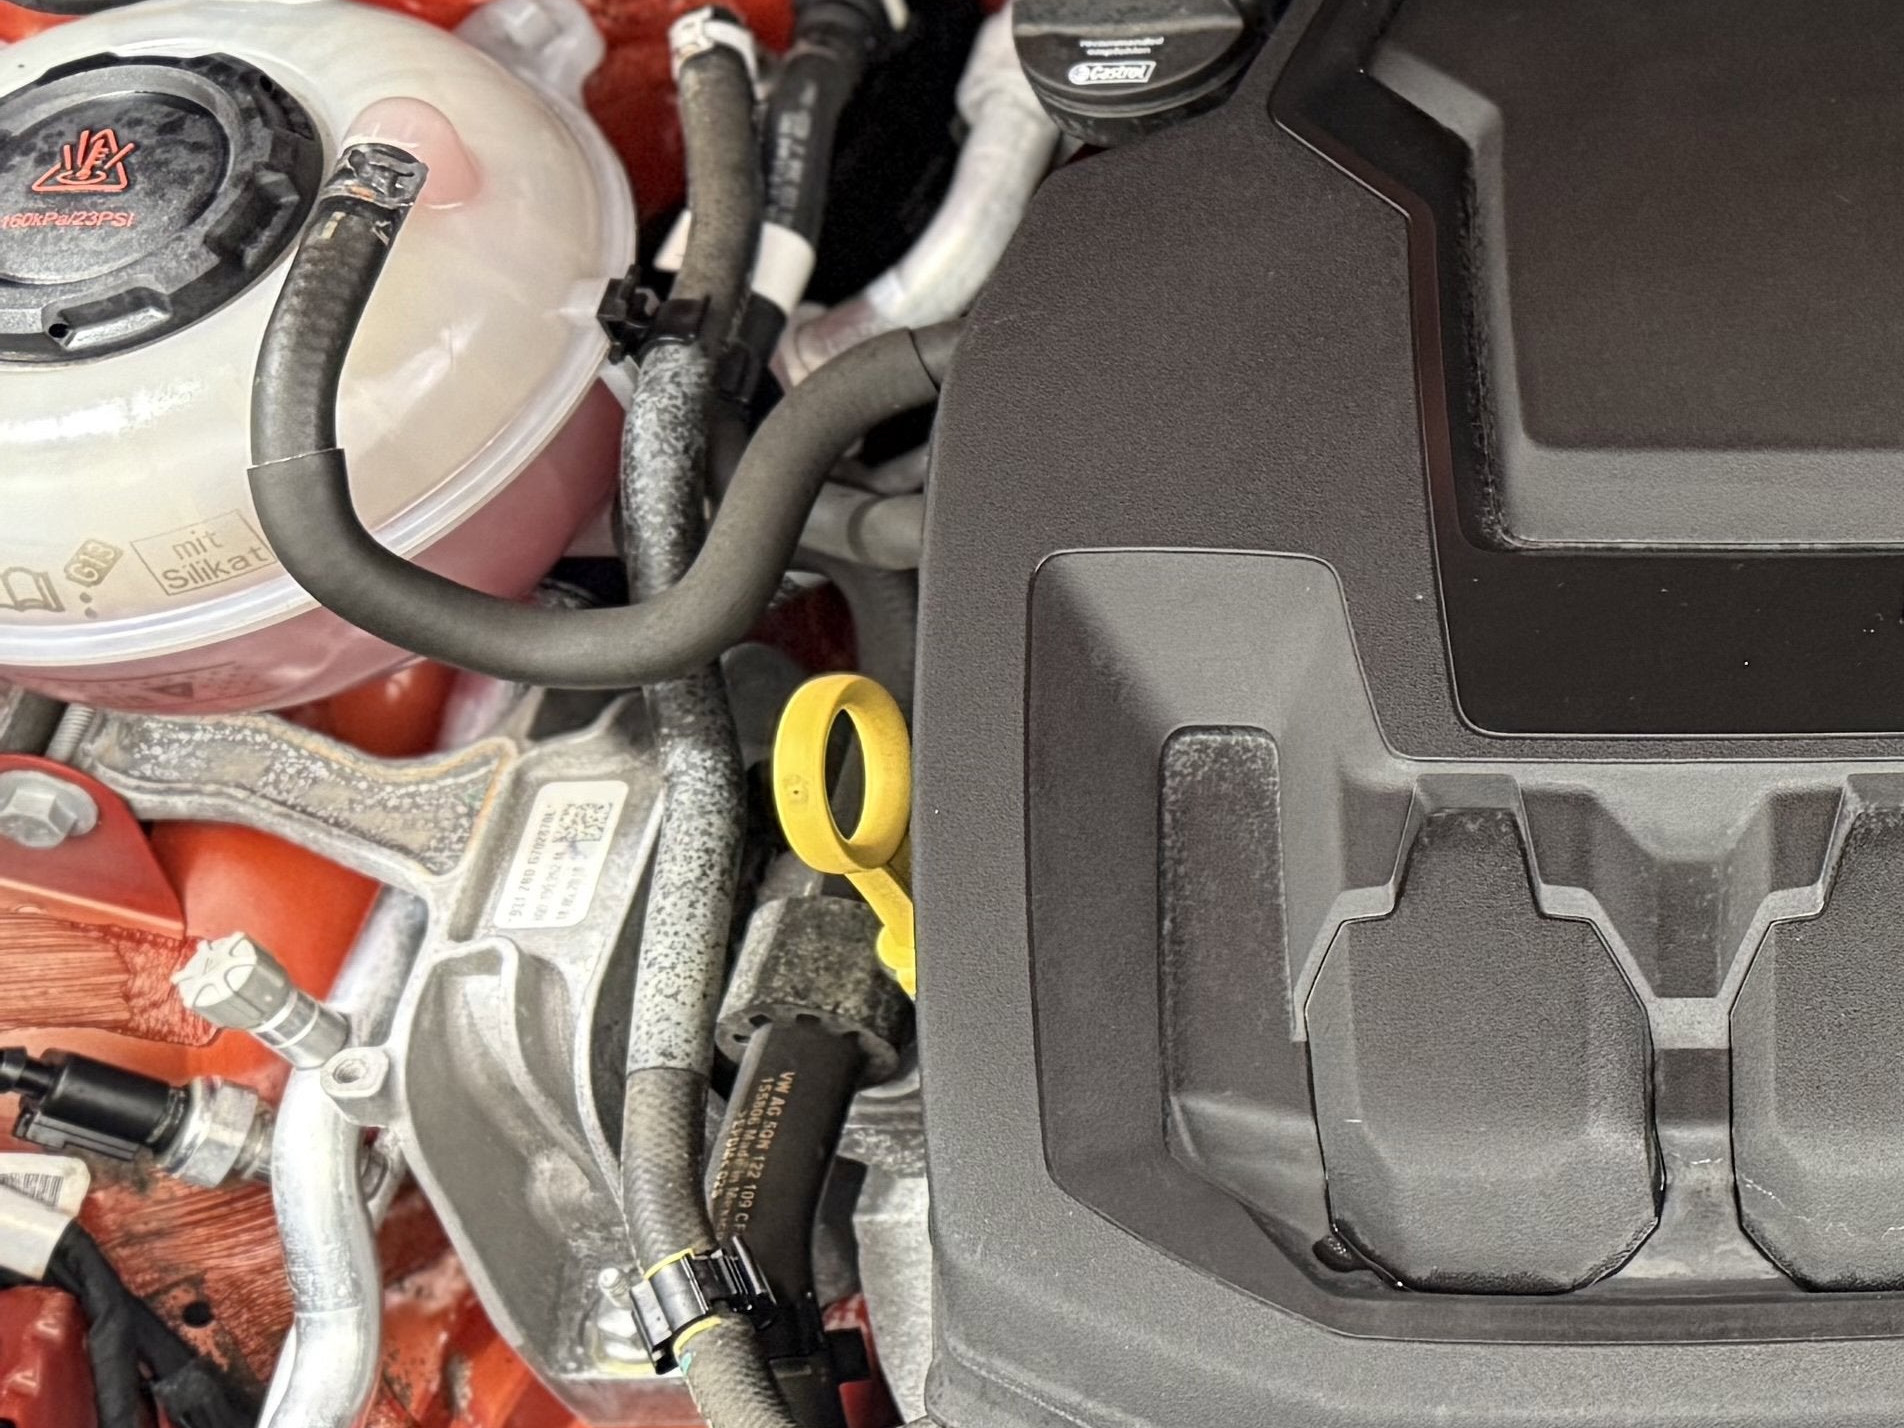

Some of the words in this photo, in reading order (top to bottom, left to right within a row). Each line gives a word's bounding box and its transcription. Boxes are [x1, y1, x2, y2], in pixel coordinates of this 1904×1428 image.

[1090, 64, 1147, 80] Castrol
[172, 529, 223, 560] mit
[161, 546, 269, 589] Silikat
[775, 1072, 795, 1094] VW
[766, 1096, 785, 1117] AG
[747, 1156, 765, 1179] 122
[738, 1184, 757, 1208] 109
